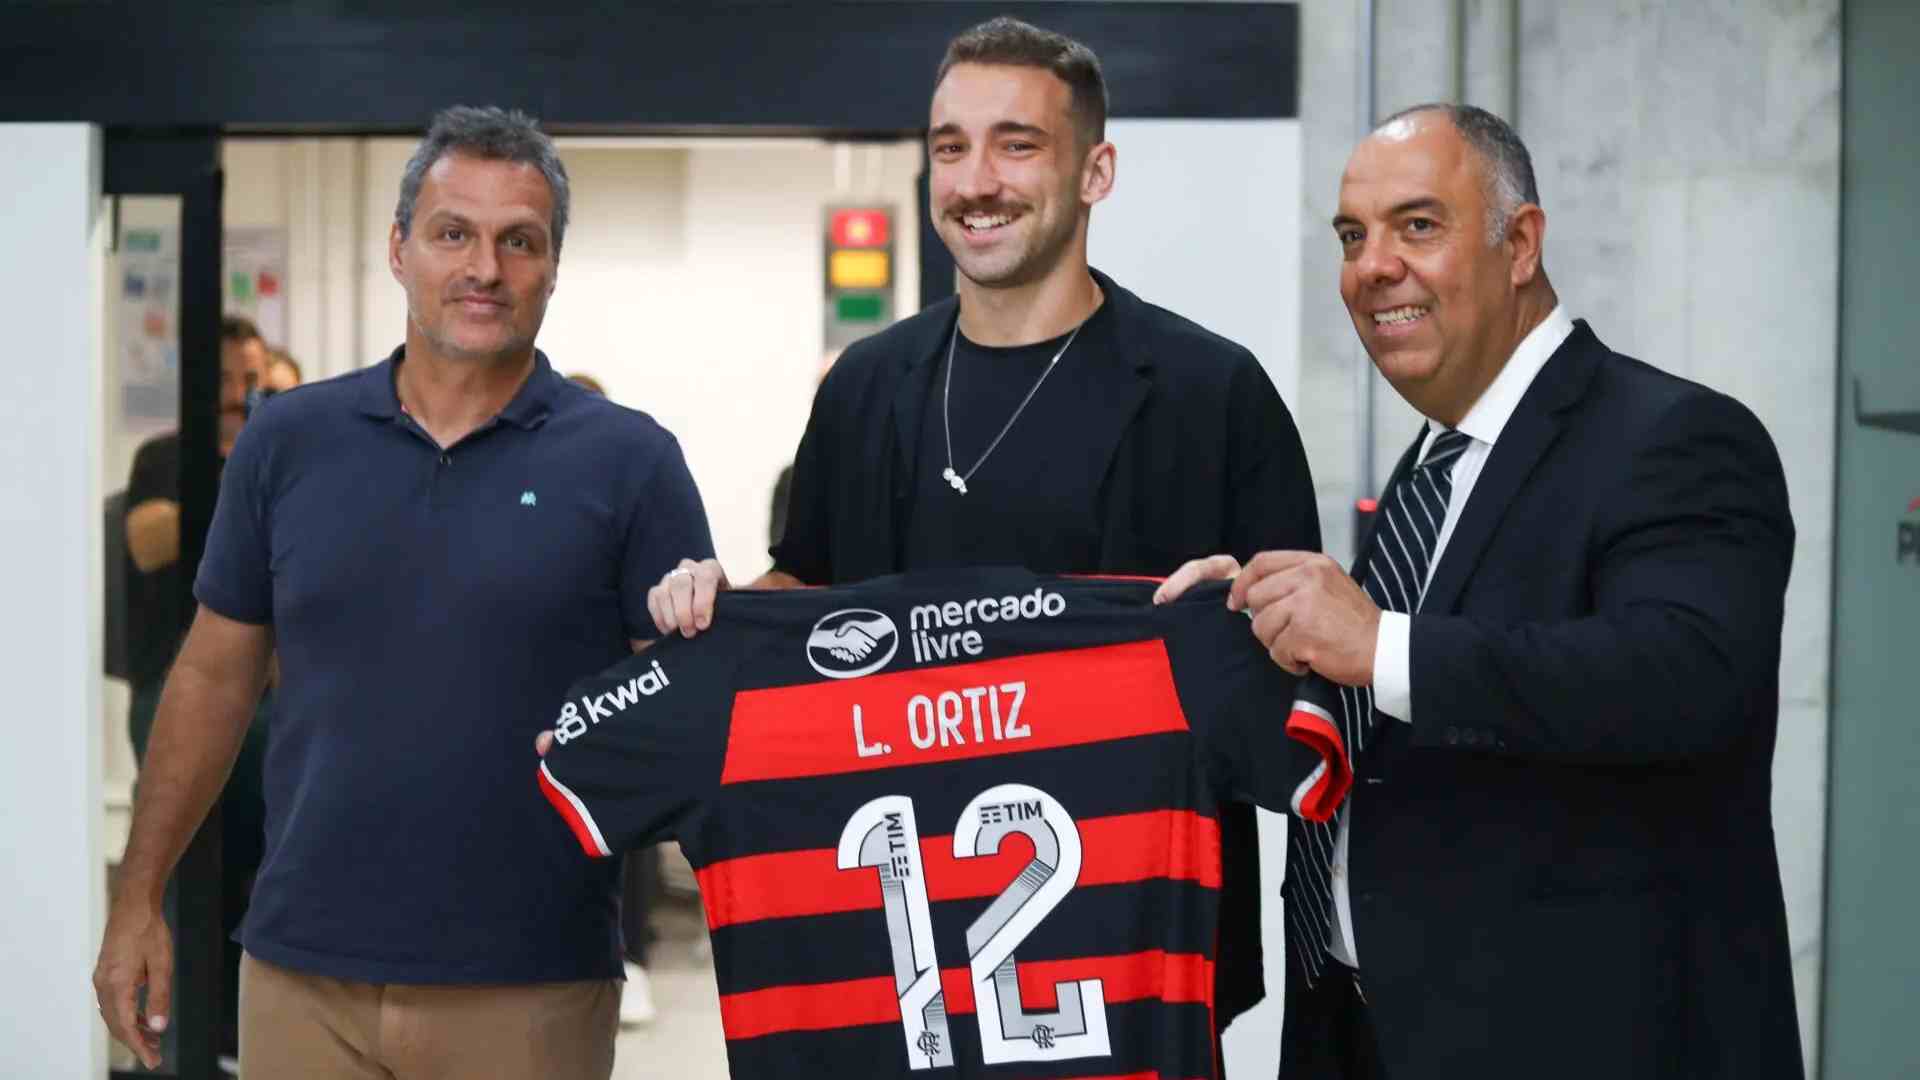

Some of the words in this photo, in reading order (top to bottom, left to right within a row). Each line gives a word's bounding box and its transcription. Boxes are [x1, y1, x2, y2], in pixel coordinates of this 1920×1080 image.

[910, 587, 1066, 630] mercado
[911, 629, 984, 663] livre
[581, 659, 670, 725] kwai
[852, 703, 892, 758] L.
[907, 681, 1031, 750] ORTIZ
[1003, 800, 1044, 822] TIM
[882, 812, 907, 854] TIM
[837, 783, 1112, 1070] 12
